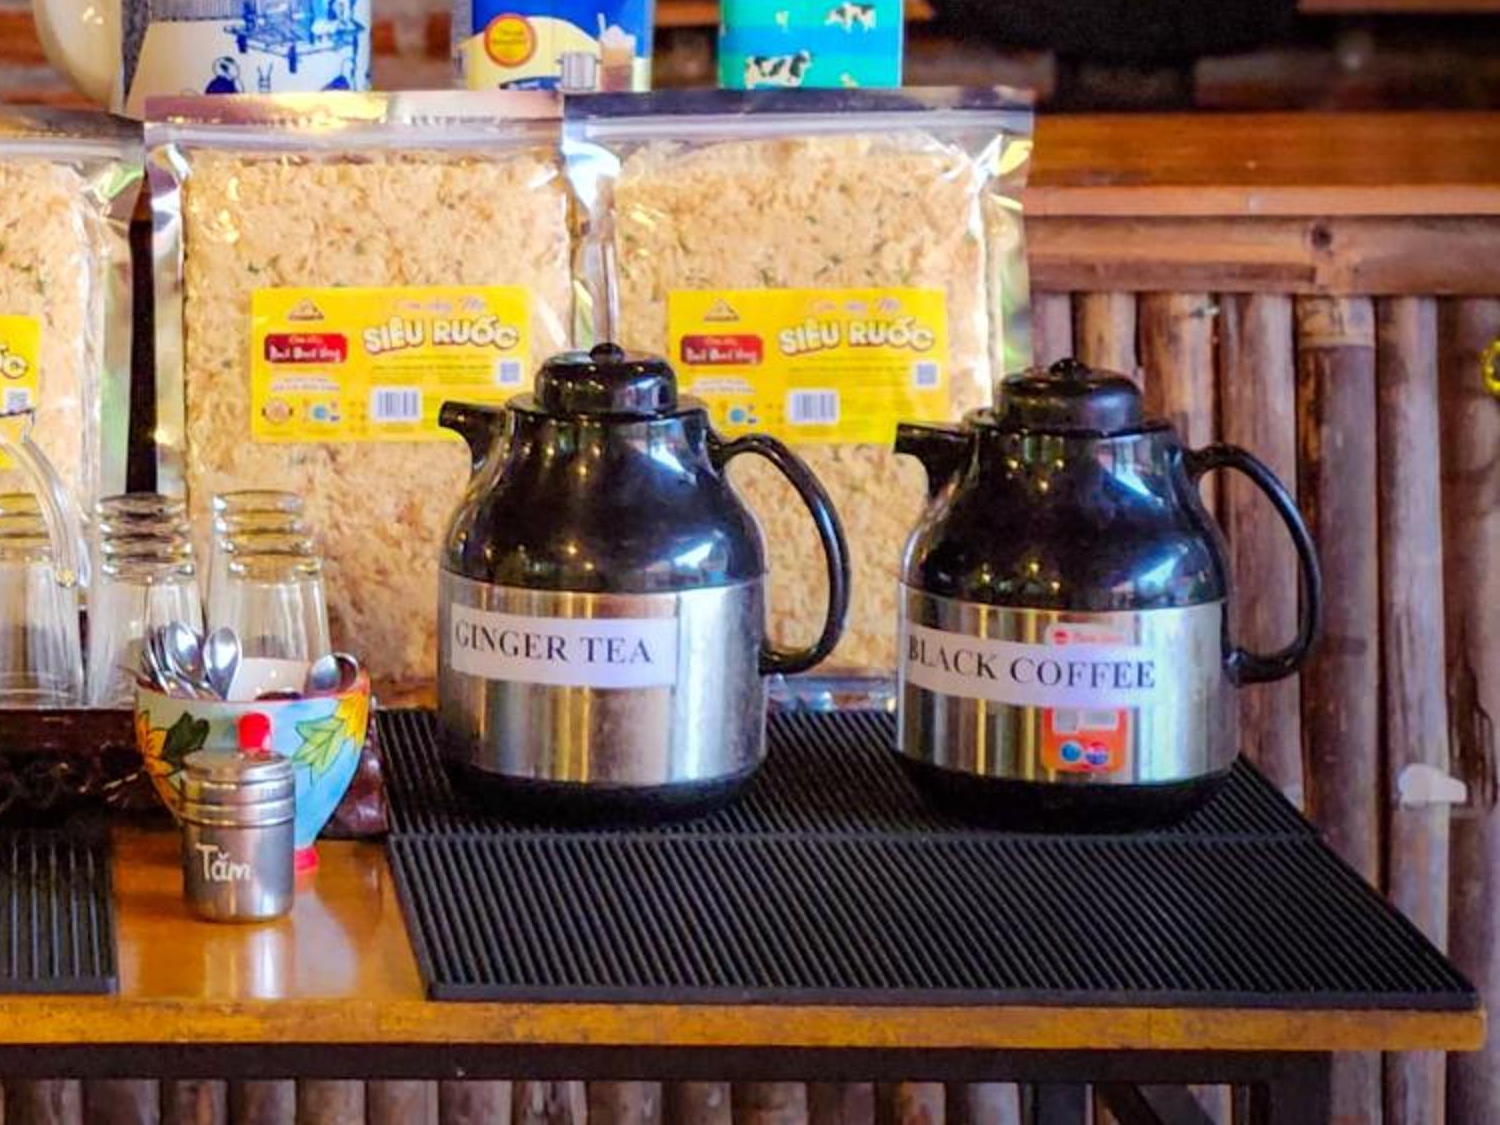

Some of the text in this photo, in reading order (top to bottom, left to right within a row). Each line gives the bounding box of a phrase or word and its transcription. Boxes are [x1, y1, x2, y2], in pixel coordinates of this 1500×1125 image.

[454, 619, 655, 665] GINGER TEA
[908, 634, 1157, 690] BLACK COFFEE
[195, 842, 251, 882] Tăm
